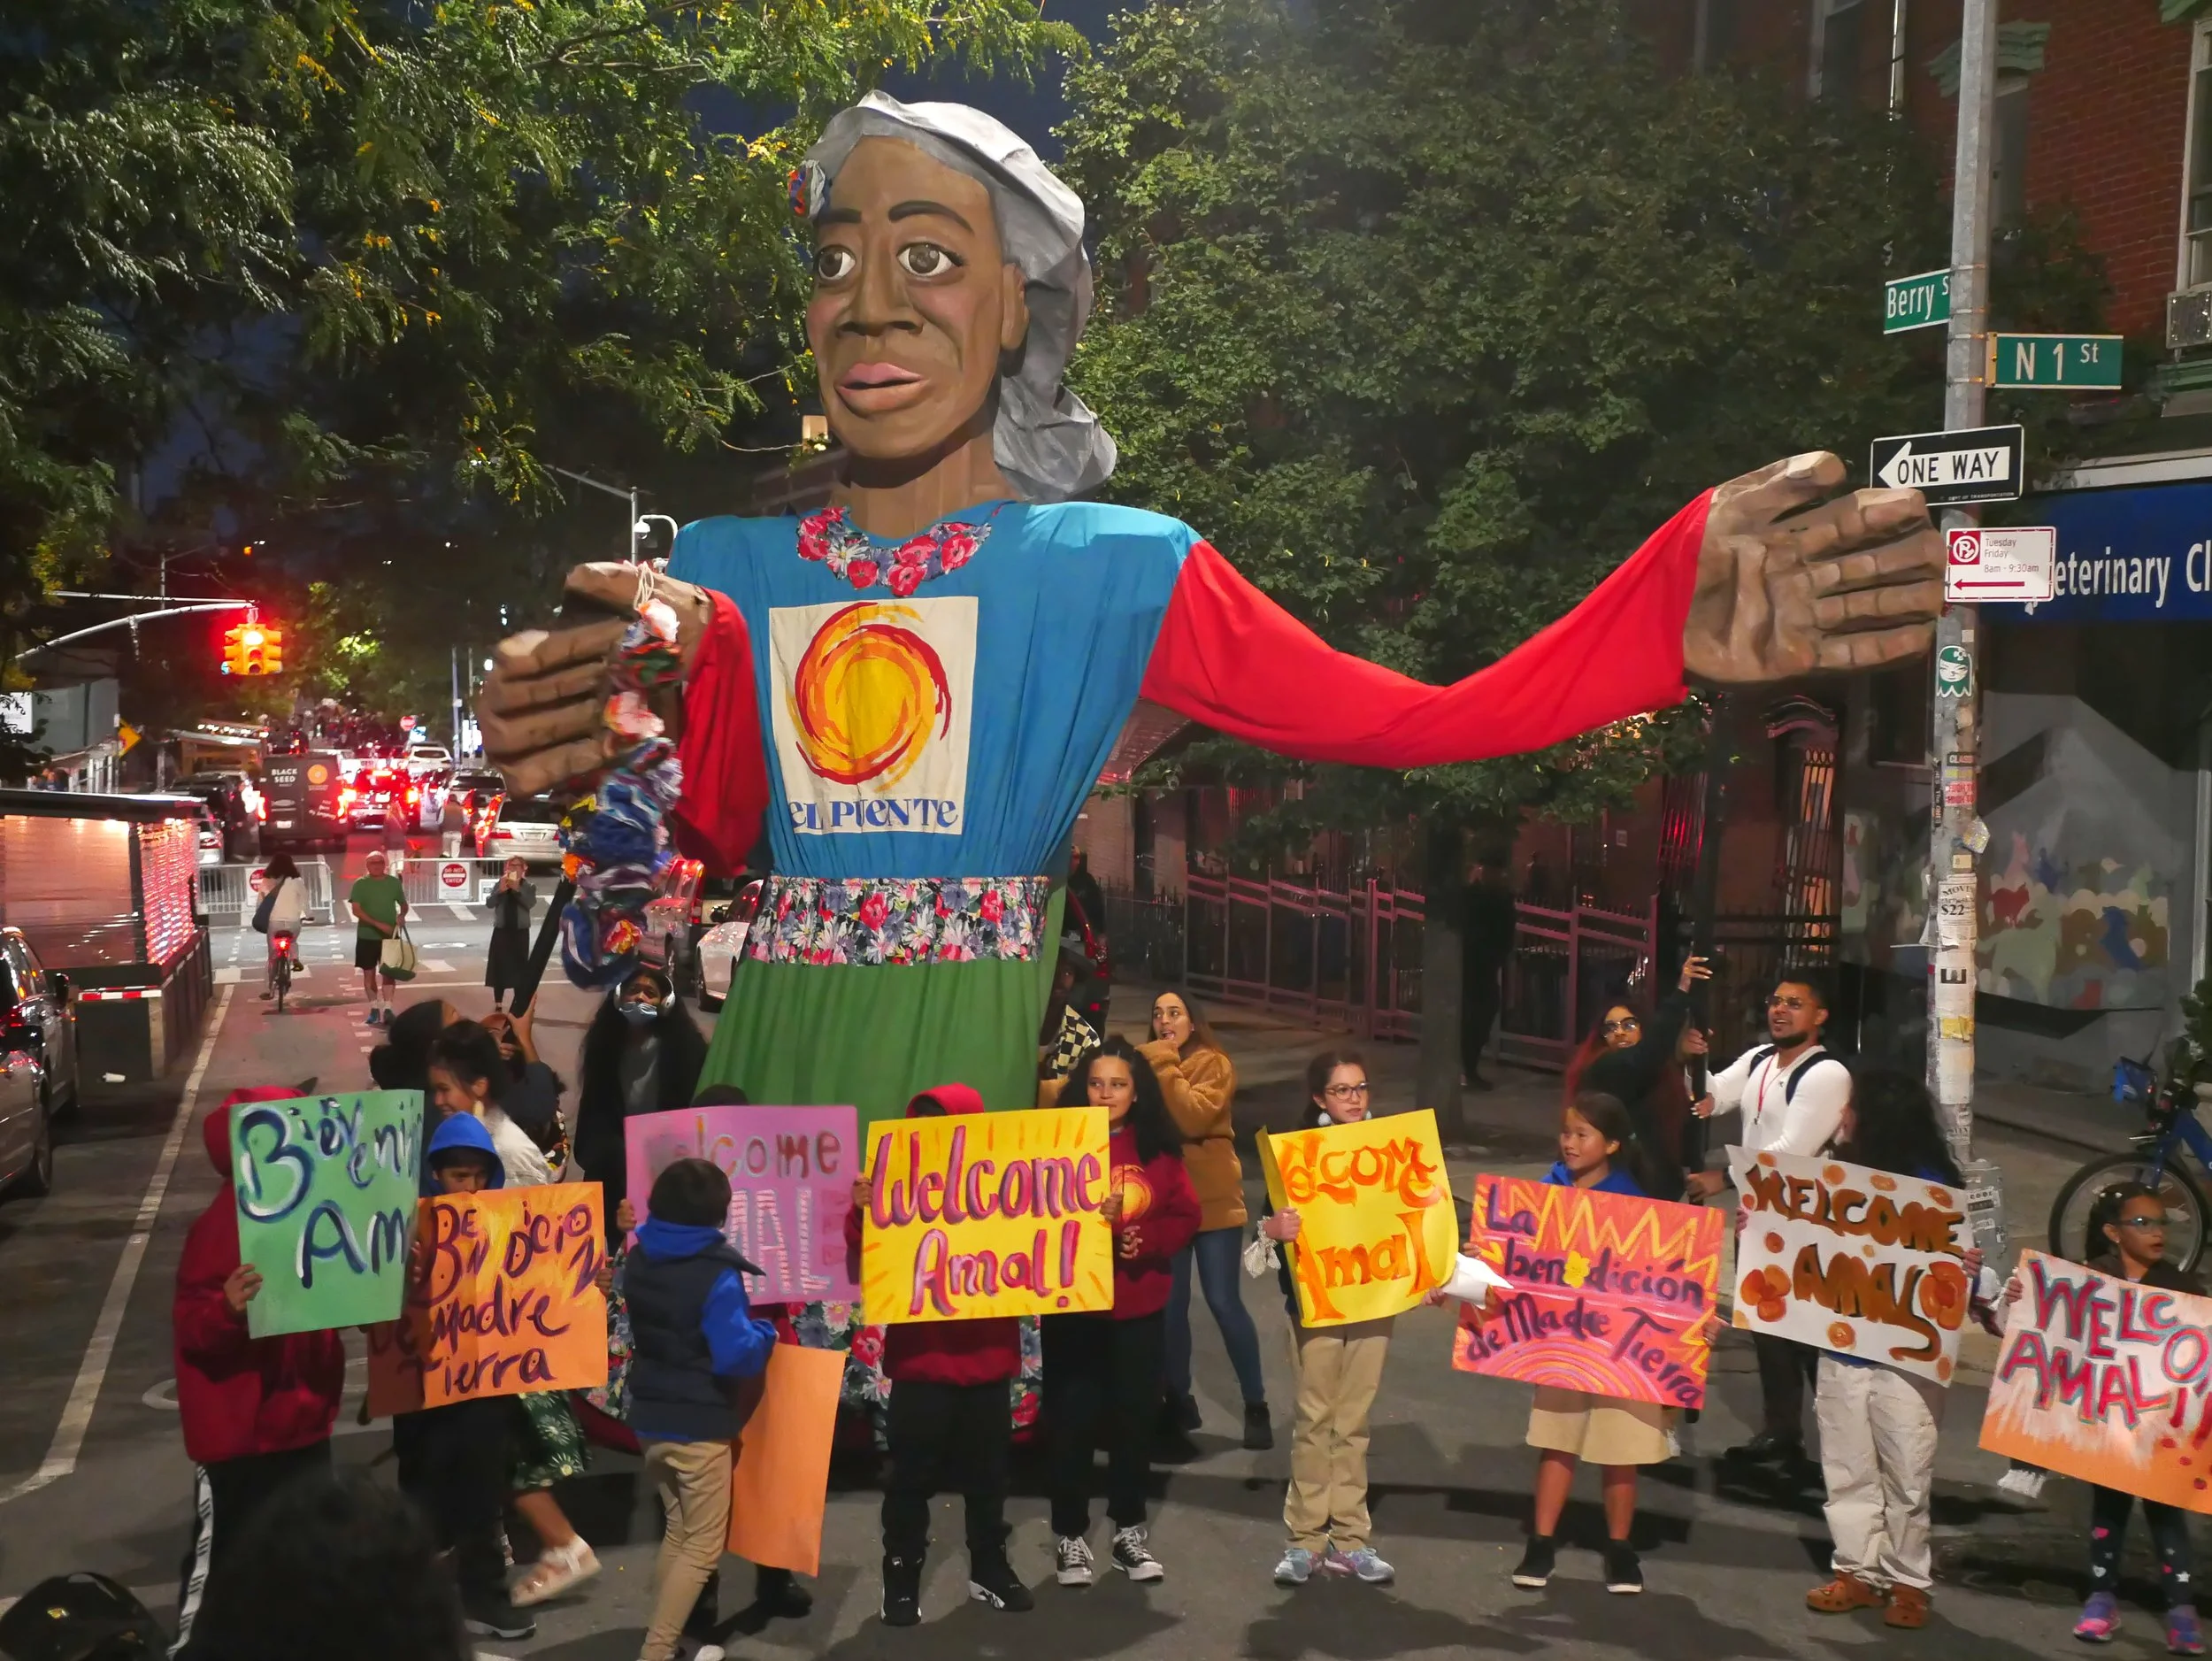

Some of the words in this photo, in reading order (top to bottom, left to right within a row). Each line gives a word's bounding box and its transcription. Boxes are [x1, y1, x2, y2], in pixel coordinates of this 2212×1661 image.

[1887, 283, 1936, 320] Berry
[1942, 275, 1950, 296] S
[2016, 342, 2036, 381] N
[2053, 342, 2064, 381] 1
[2080, 342, 2099, 364] St
[1897, 456, 1939, 485] ONE
[1953, 450, 2000, 481] WAY
[1985, 538, 2016, 548] Tuesday
[1985, 550, 2009, 559] Friday
[1985, 565, 2001, 573] 8am
[2008, 564, 2039, 573] 9:30am
[2054, 545, 2170, 609] eterinary
[870, 1124, 1103, 1229] Welcome
[1487, 1183, 1537, 1235] La
[1745, 1164, 1964, 1258] WELCOME
[909, 1220, 1081, 1317] Amal!
[1466, 1321, 1504, 1362] de
[2027, 1258, 2212, 1396] WELCO
